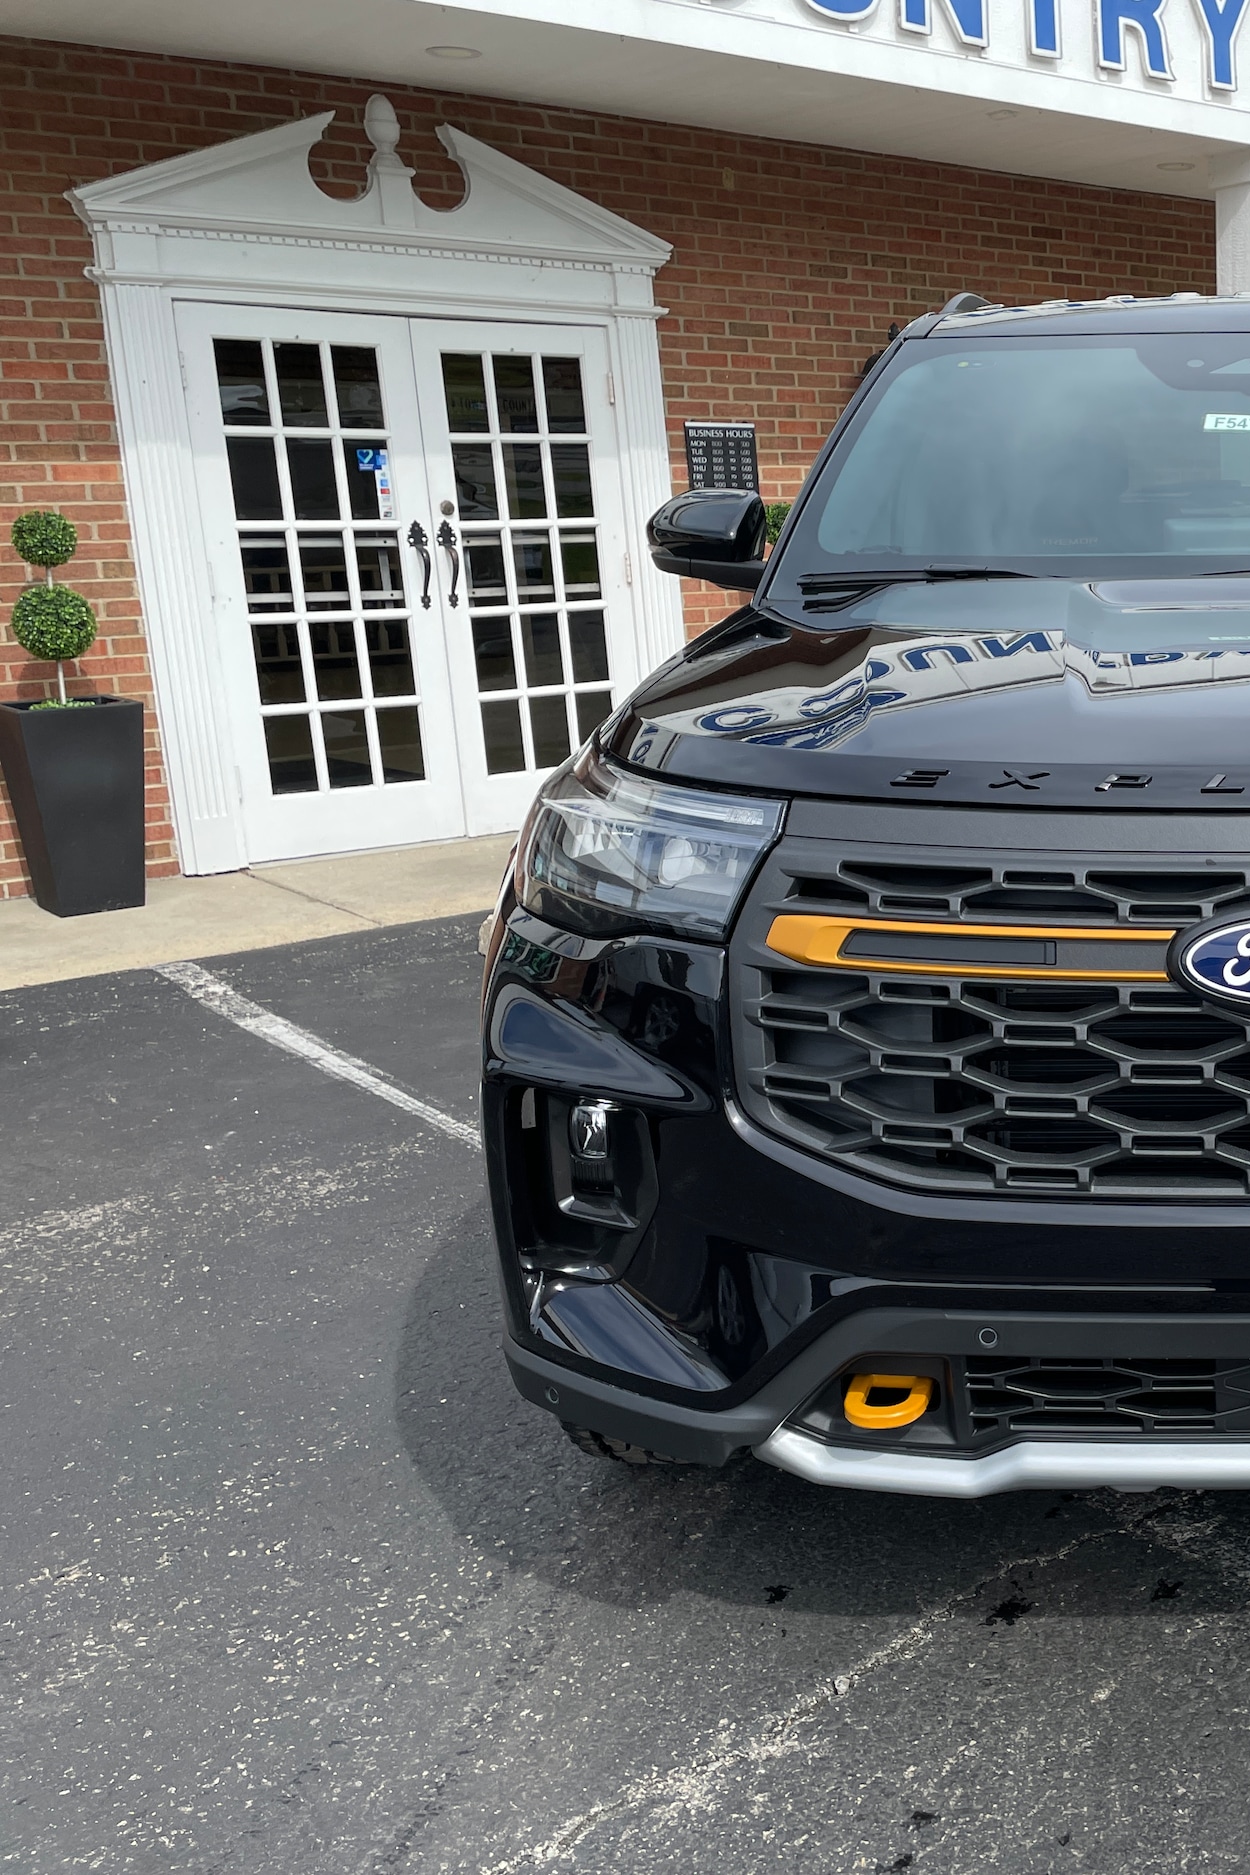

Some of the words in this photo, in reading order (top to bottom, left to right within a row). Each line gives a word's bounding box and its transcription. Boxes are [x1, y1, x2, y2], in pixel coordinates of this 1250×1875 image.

[688, 429, 724, 438] BUSINESS
[725, 429, 754, 439] HOURS
[691, 448, 704, 456] TUE
[691, 456, 708, 464] WED
